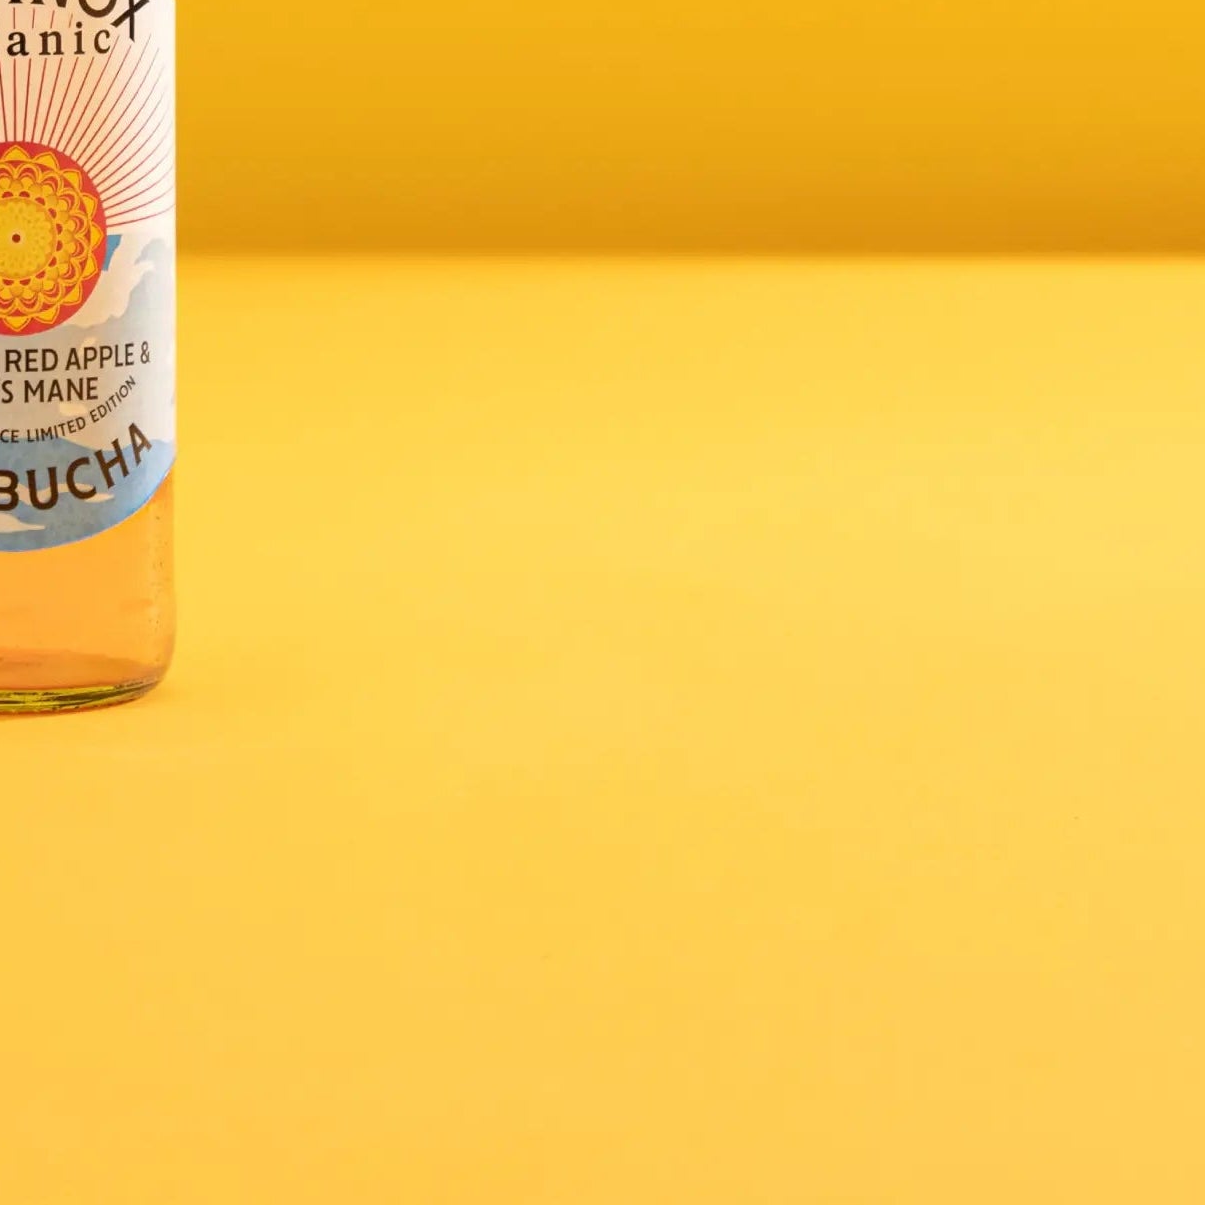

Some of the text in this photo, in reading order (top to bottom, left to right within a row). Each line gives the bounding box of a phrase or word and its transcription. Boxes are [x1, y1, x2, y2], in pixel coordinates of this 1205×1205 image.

[5, 348, 59, 373] RED
[65, 343, 135, 371] APPLE
[140, 341, 150, 364] &
[23, 377, 99, 403] MANE
[27, 417, 86, 442] LIMITED
[89, 375, 136, 423] EDITION
